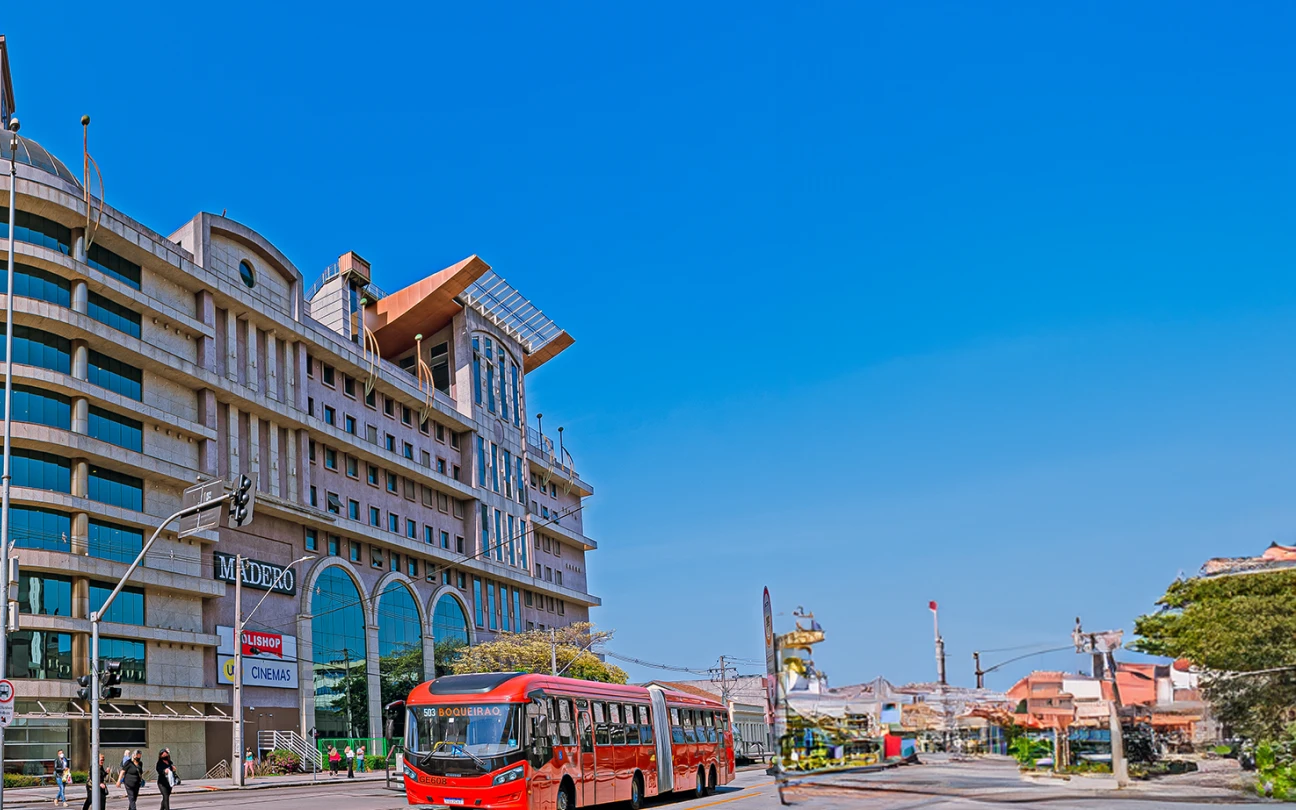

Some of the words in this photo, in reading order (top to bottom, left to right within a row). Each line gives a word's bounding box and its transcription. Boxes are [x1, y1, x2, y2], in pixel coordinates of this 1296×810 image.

[219, 556, 294, 591] MADERO
[241, 633, 281, 649] OLISHOP
[251, 666, 291, 681] CINEMAS
[423, 708, 436, 717] 503
[419, 775, 447, 785] GE608
